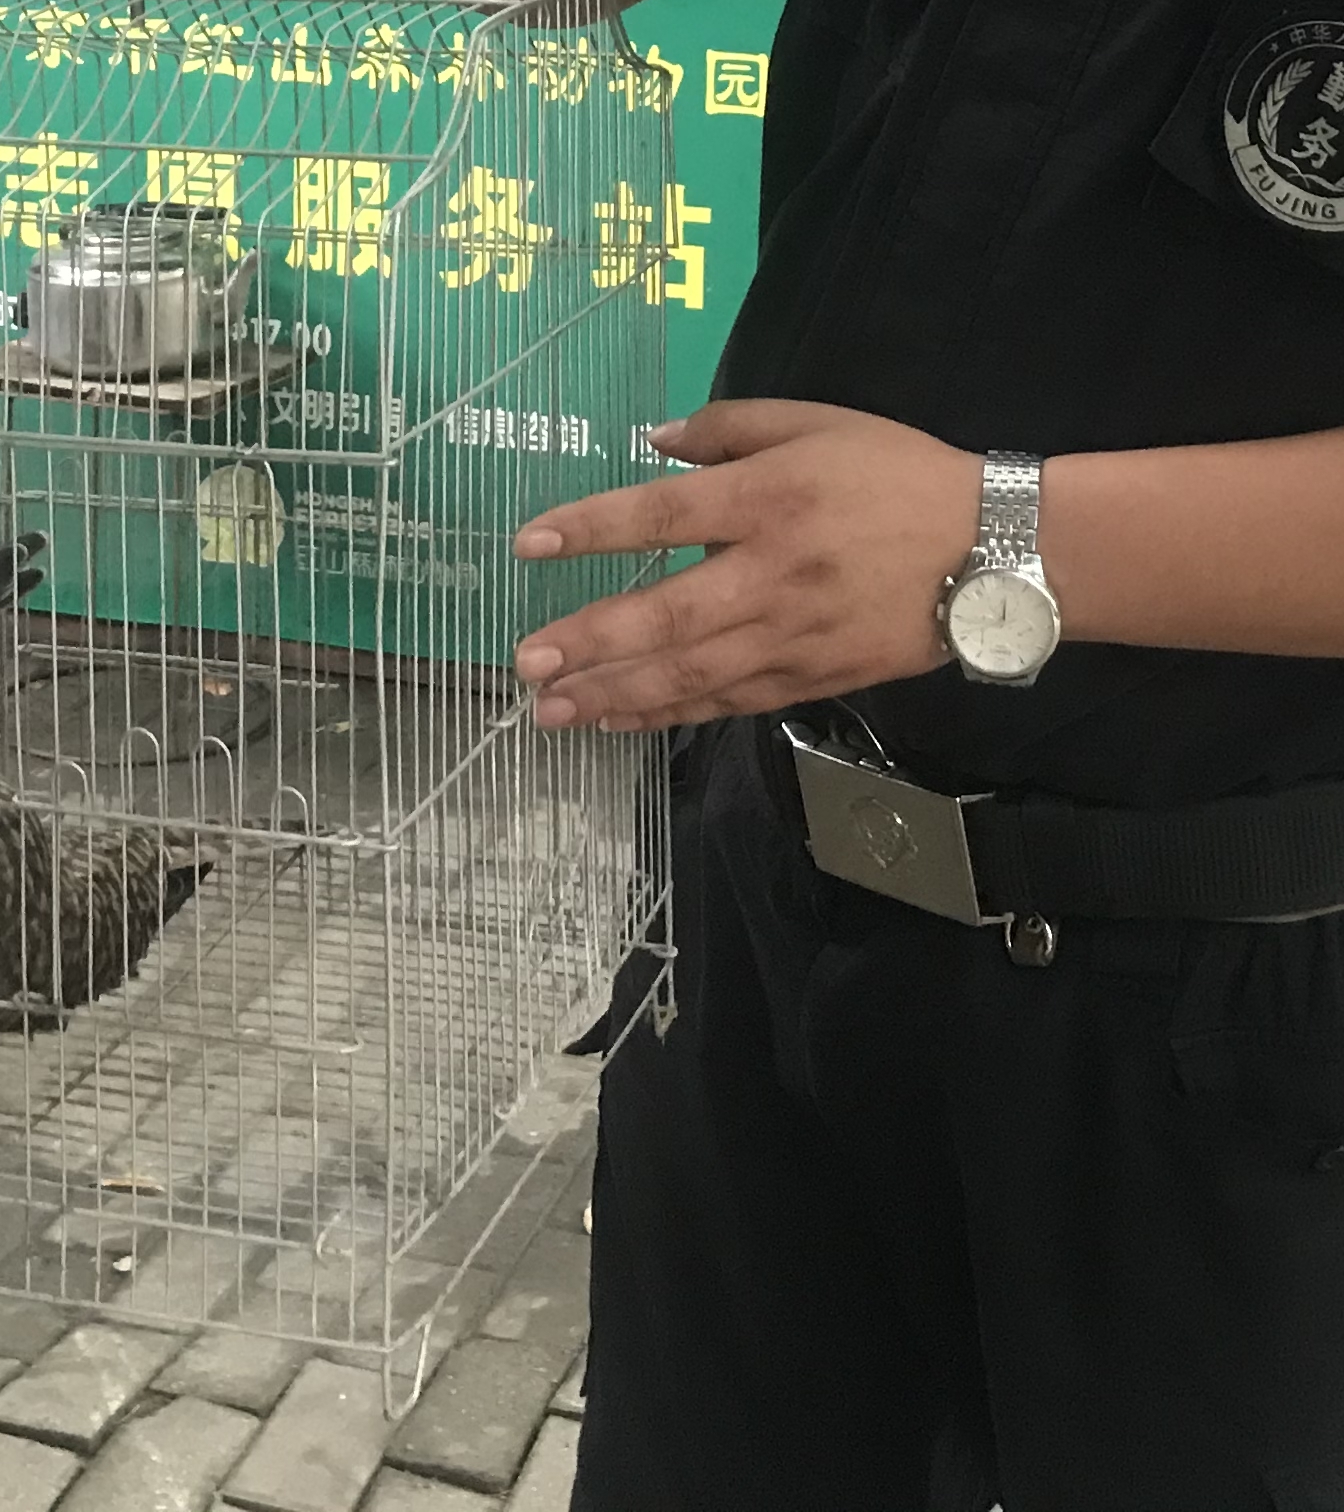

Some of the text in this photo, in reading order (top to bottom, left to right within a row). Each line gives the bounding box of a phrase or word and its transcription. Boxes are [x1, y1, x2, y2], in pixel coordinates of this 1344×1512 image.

[1248, 163, 1337, 219] FU JING
[295, 490, 400, 516] HONGSHN
